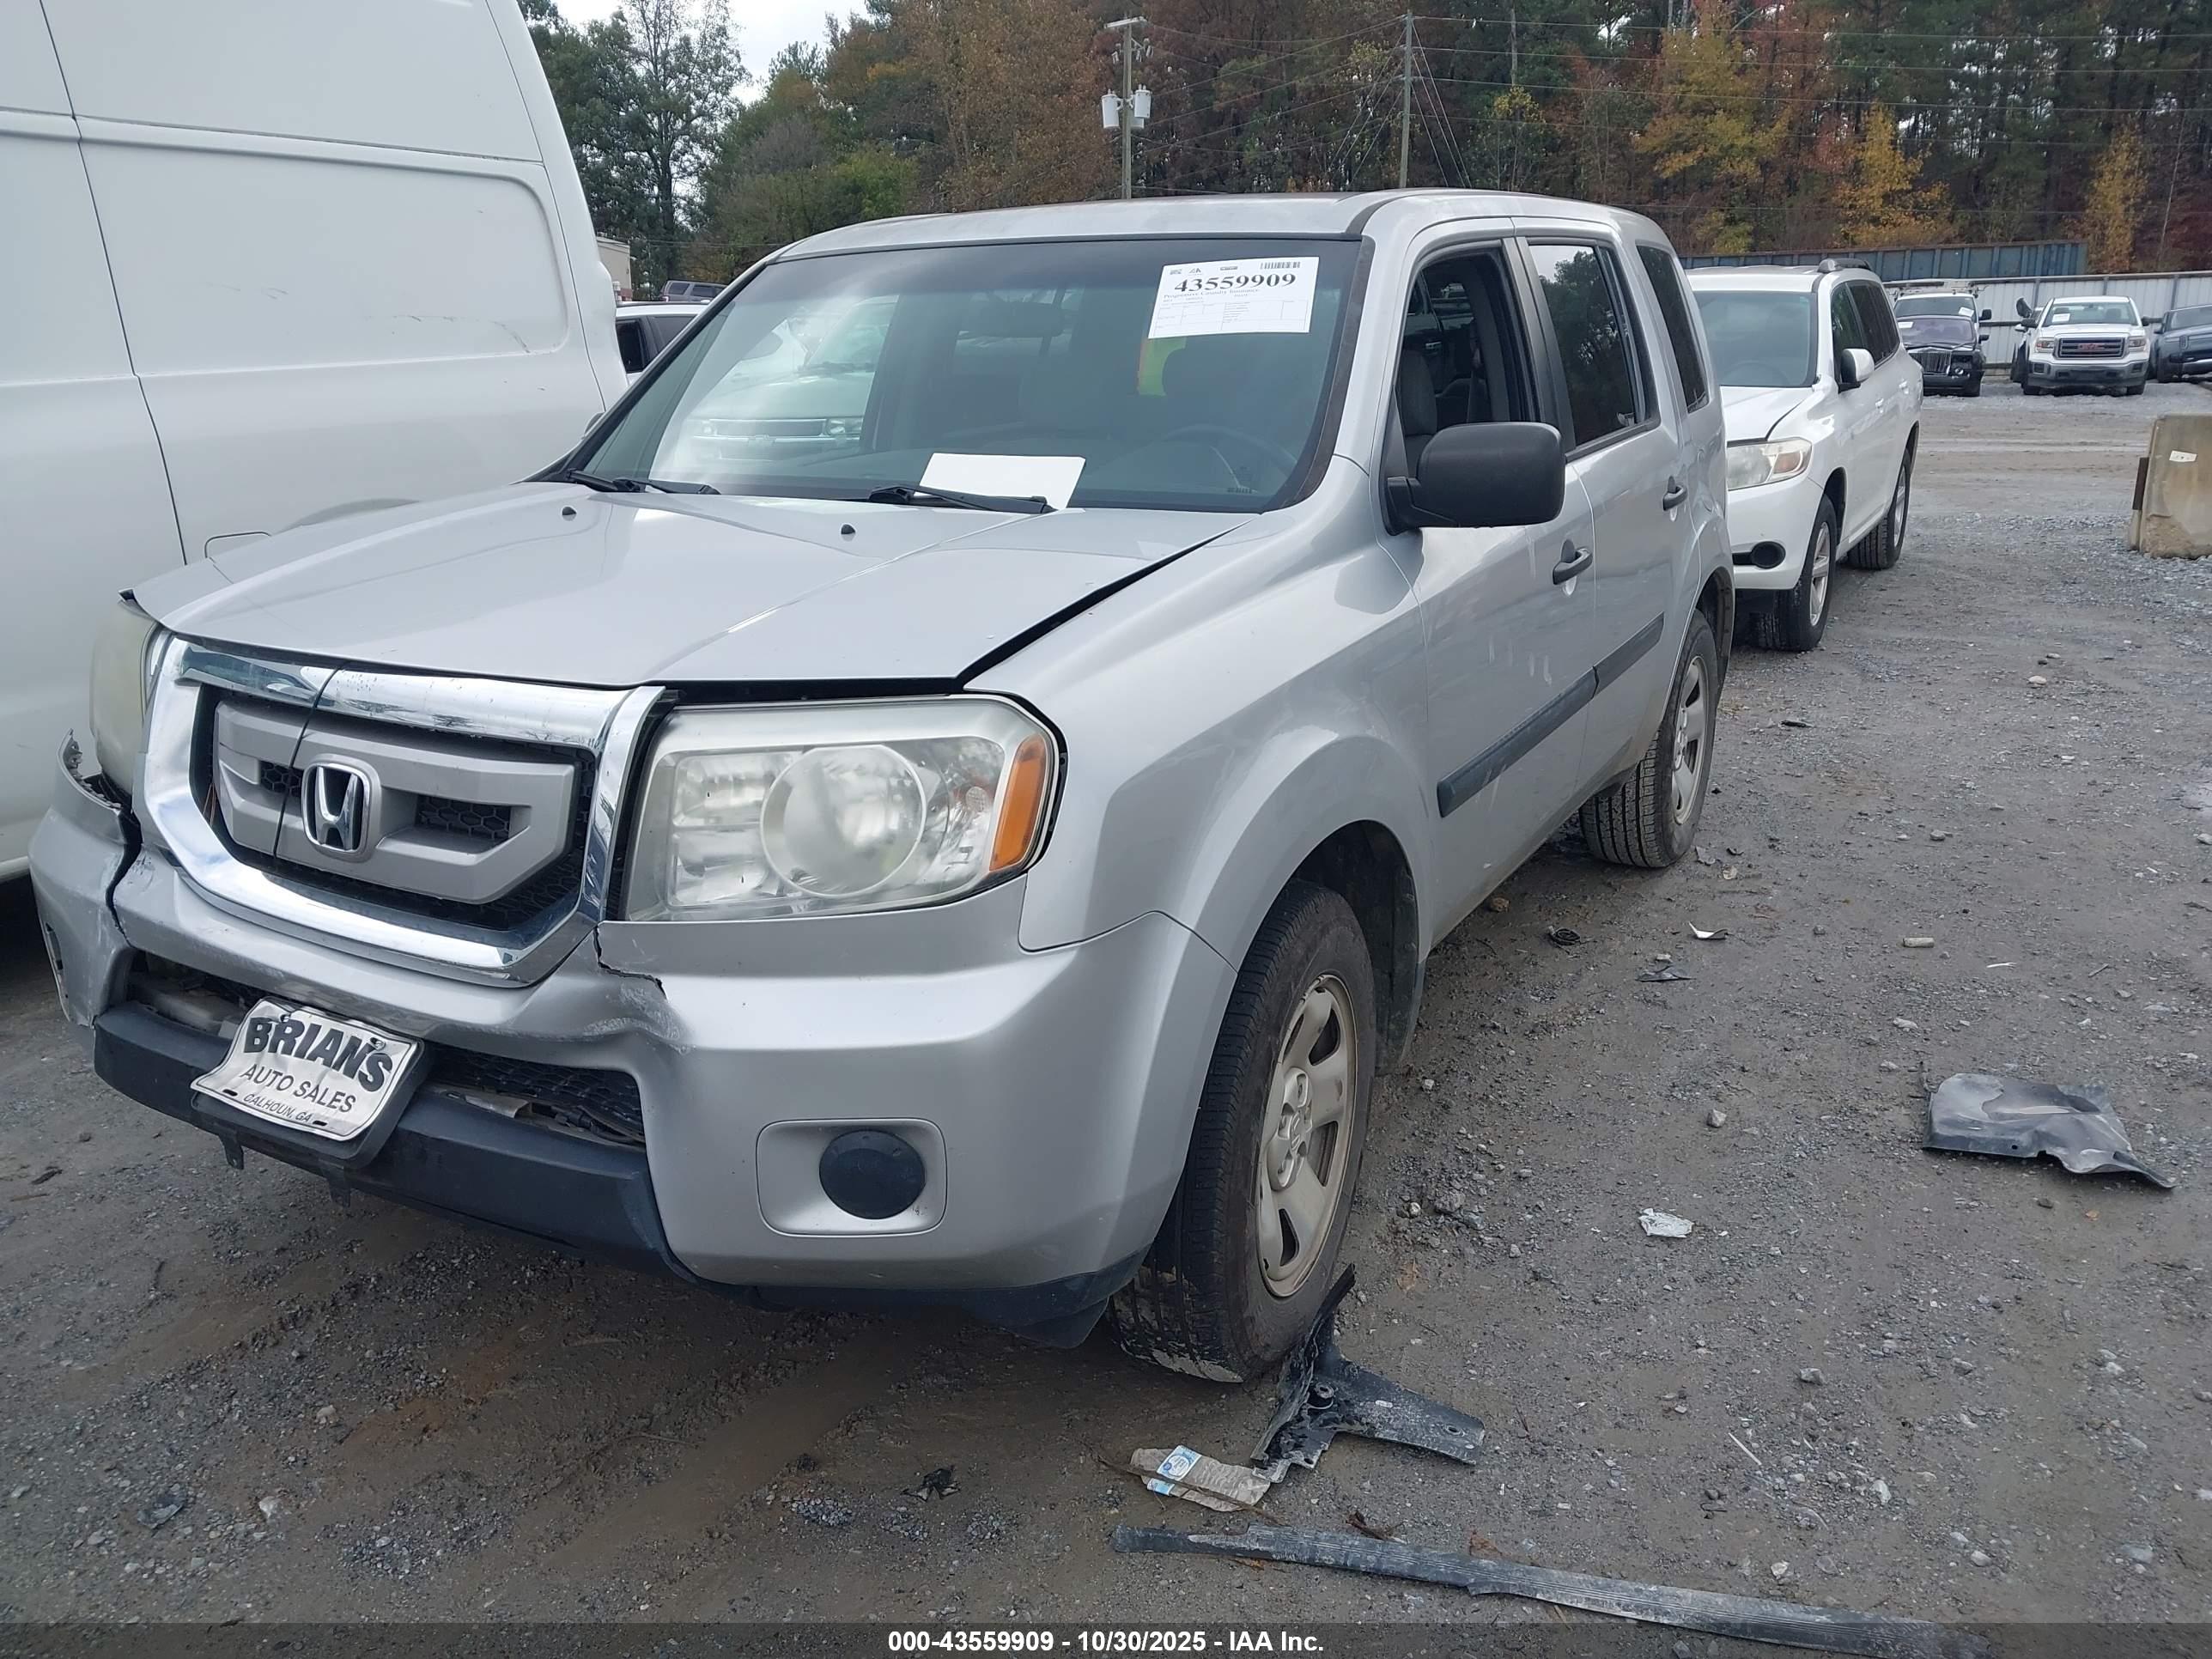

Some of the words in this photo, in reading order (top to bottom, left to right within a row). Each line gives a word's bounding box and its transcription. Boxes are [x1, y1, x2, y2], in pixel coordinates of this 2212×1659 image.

[1174, 273, 1297, 293] 43559909
[240, 1063, 295, 1091] AUTO
[295, 1080, 356, 1113] SALES
[243, 1093, 294, 1119] CALHOUN,
[295, 1111, 313, 1123] GA
